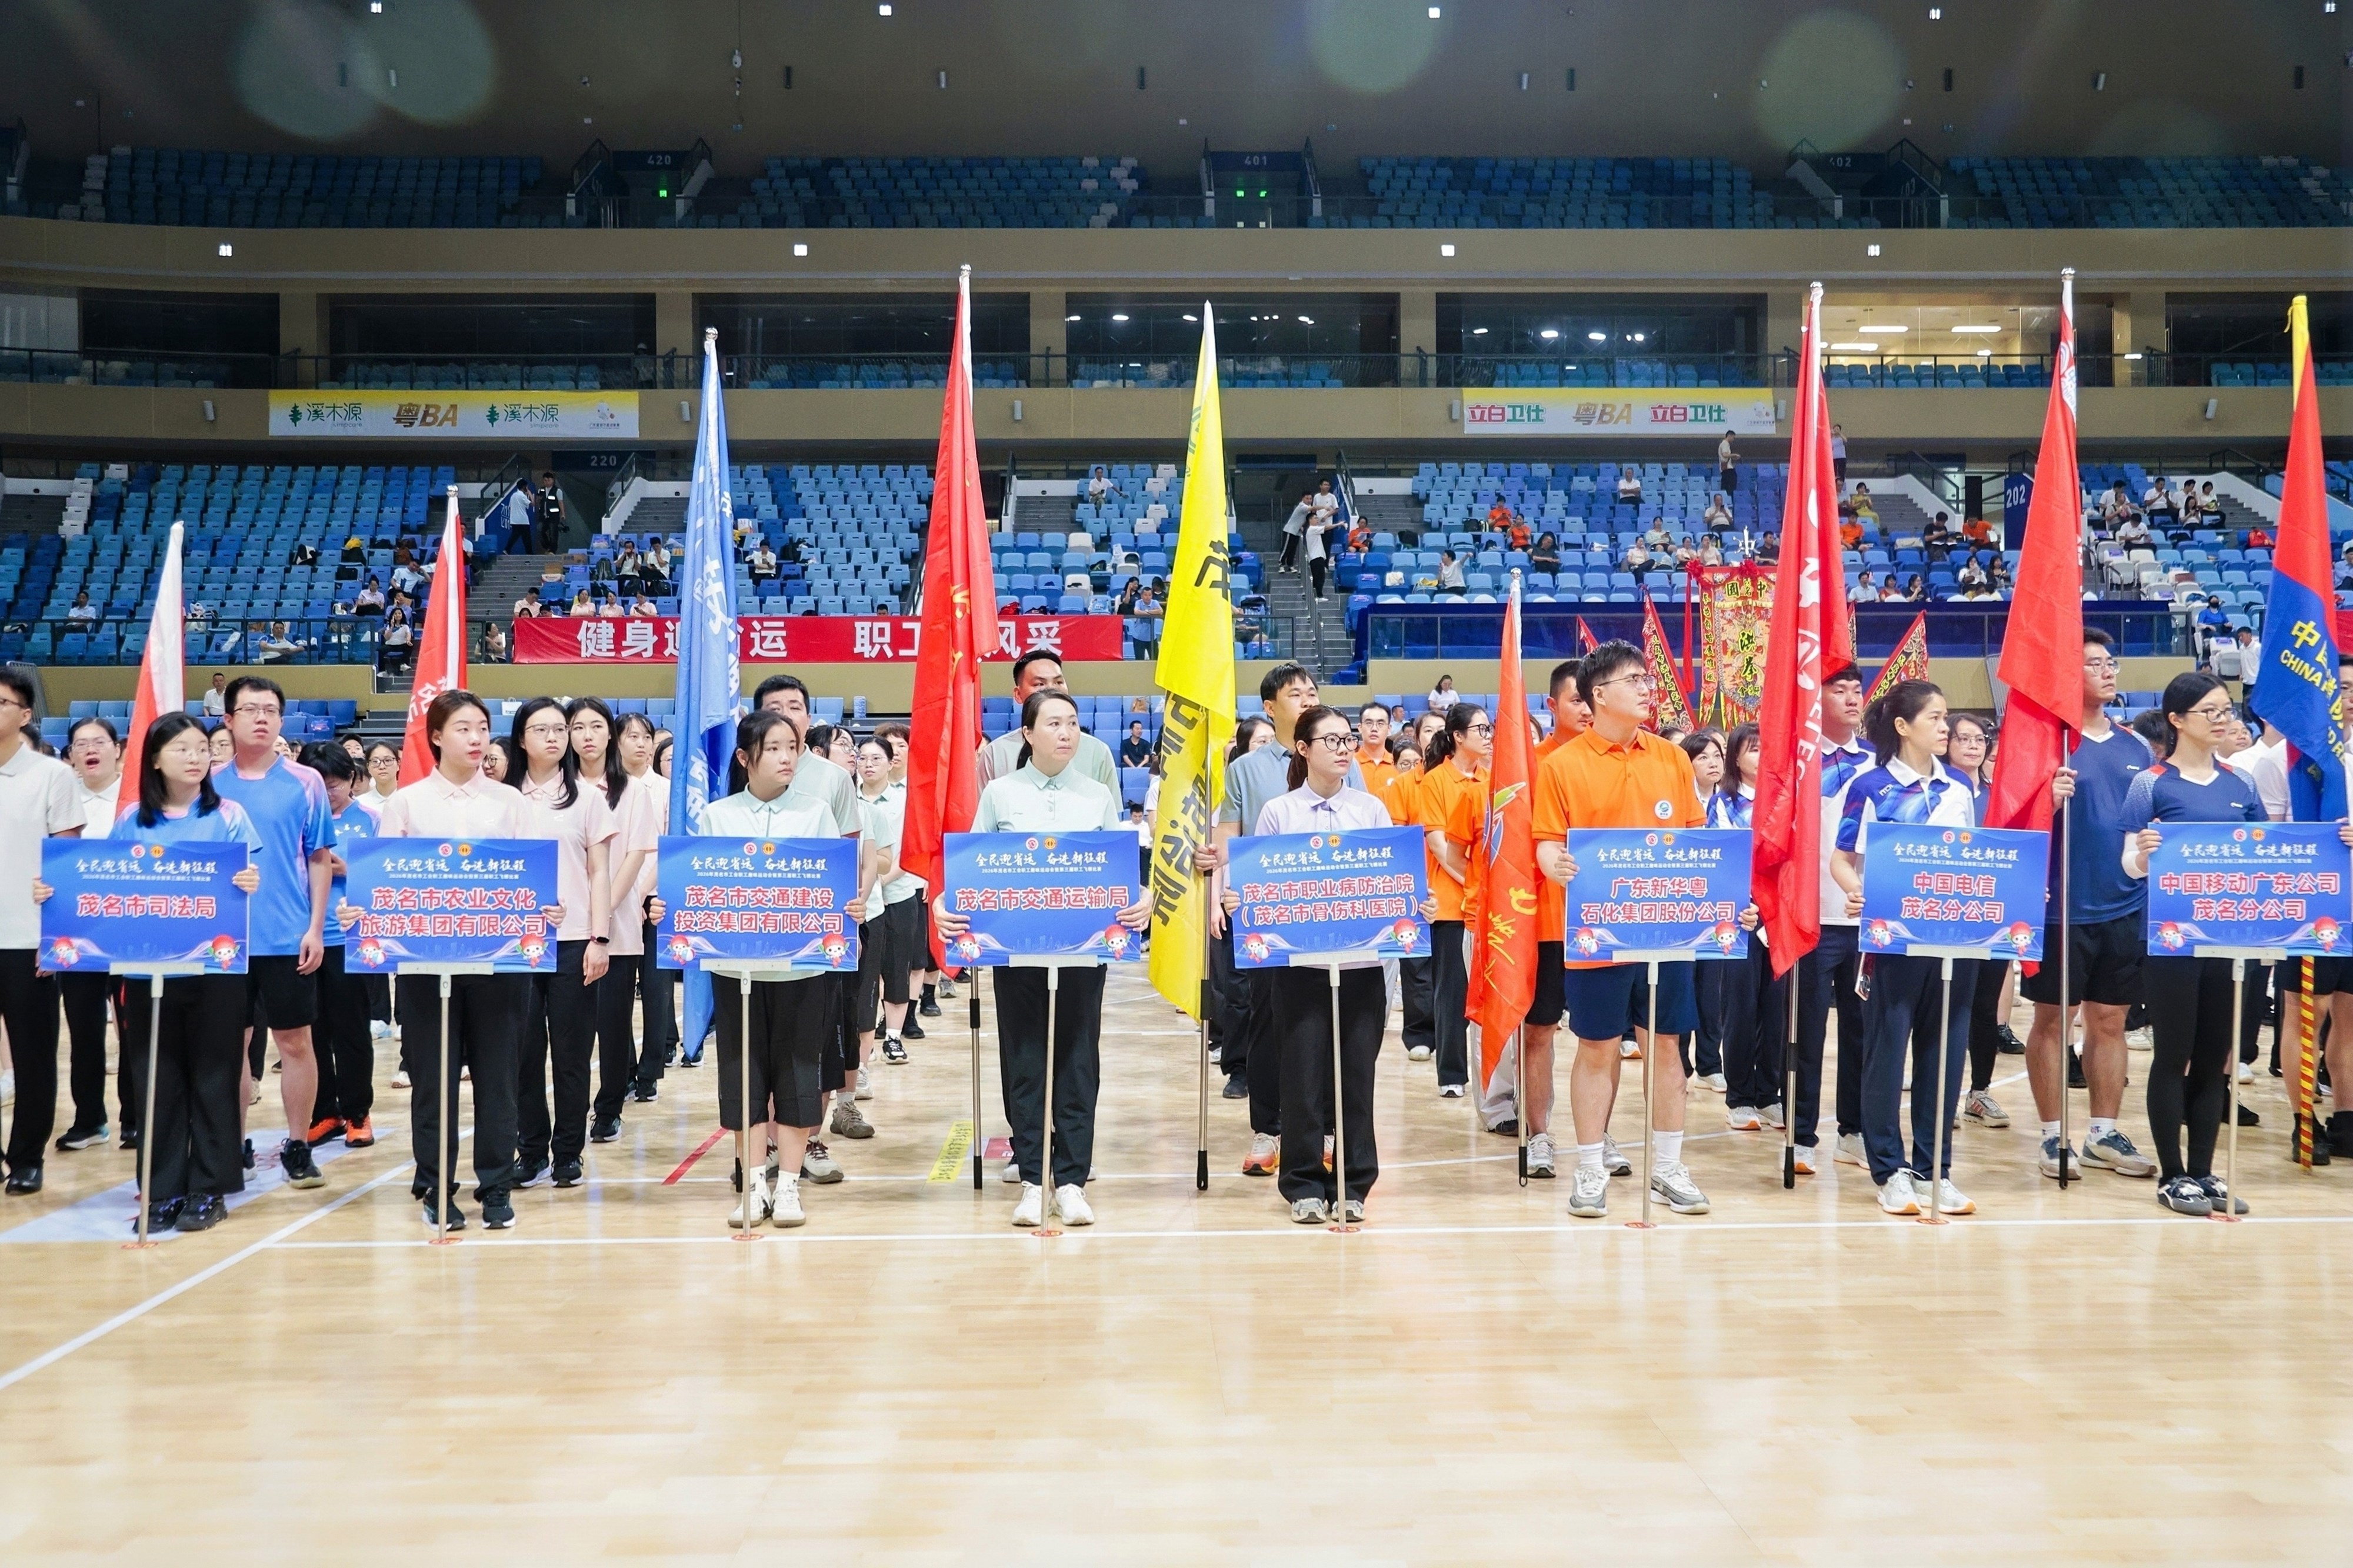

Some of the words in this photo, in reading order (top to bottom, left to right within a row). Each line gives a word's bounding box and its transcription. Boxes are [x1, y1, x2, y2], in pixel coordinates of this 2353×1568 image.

[647, 155, 671, 165] 420
[1244, 155, 1267, 165] 401
[306, 402, 362, 422] 溪木源
[392, 402, 458, 428] 粤BA
[503, 403, 559, 422] 溪木源
[1468, 403, 1545, 423] 立白卫仕
[1572, 402, 1632, 426] 粤BA
[1650, 404, 1727, 423] 立白卫仕
[590, 455, 617, 466] 220
[2006, 483, 2026, 509] 202
[975, 853, 1037, 868] 全民迎省运
[1045, 850, 1109, 866] 奋进新征程
[1259, 851, 1323, 868] 全民迎省运
[1331, 846, 1395, 863] 奋进新征程
[1597, 848, 1656, 862] 全民迎省运
[1664, 847, 1723, 863] 奋进新征程
[1893, 842, 1952, 859] 全民迎省运
[1960, 846, 2020, 862] 奋进新征程
[382, 858, 451, 872] 全民迎省运
[459, 858, 527, 873] 奋进新征程
[690, 856, 755, 871] 全民迎省运
[764, 857, 829, 873] 奋进新征程
[1242, 873, 1415, 905] 茂名市职业病防治院
[1610, 876, 1708, 899] 广东新华粤
[1912, 870, 1997, 898] 中国电信
[2158, 872, 2341, 896] 中国移动广东公司
[76, 893, 216, 919] 茂名市司法局
[371, 886, 537, 911] 茂名市农业文化
[685, 886, 834, 910] 茂名市交通建设
[955, 886, 1129, 912] 茂名市交通运输局
[1899, 896, 2005, 924] 茂名分公司
[2191, 898, 2307, 922] 茂名分公司
[674, 910, 844, 935] 投资集团有限公司
[1239, 895, 1420, 928] （茂名市骨伤科医院）
[1580, 901, 1736, 925] 石化集团股份公司
[359, 913, 547, 938] 旅游集团有限公司
